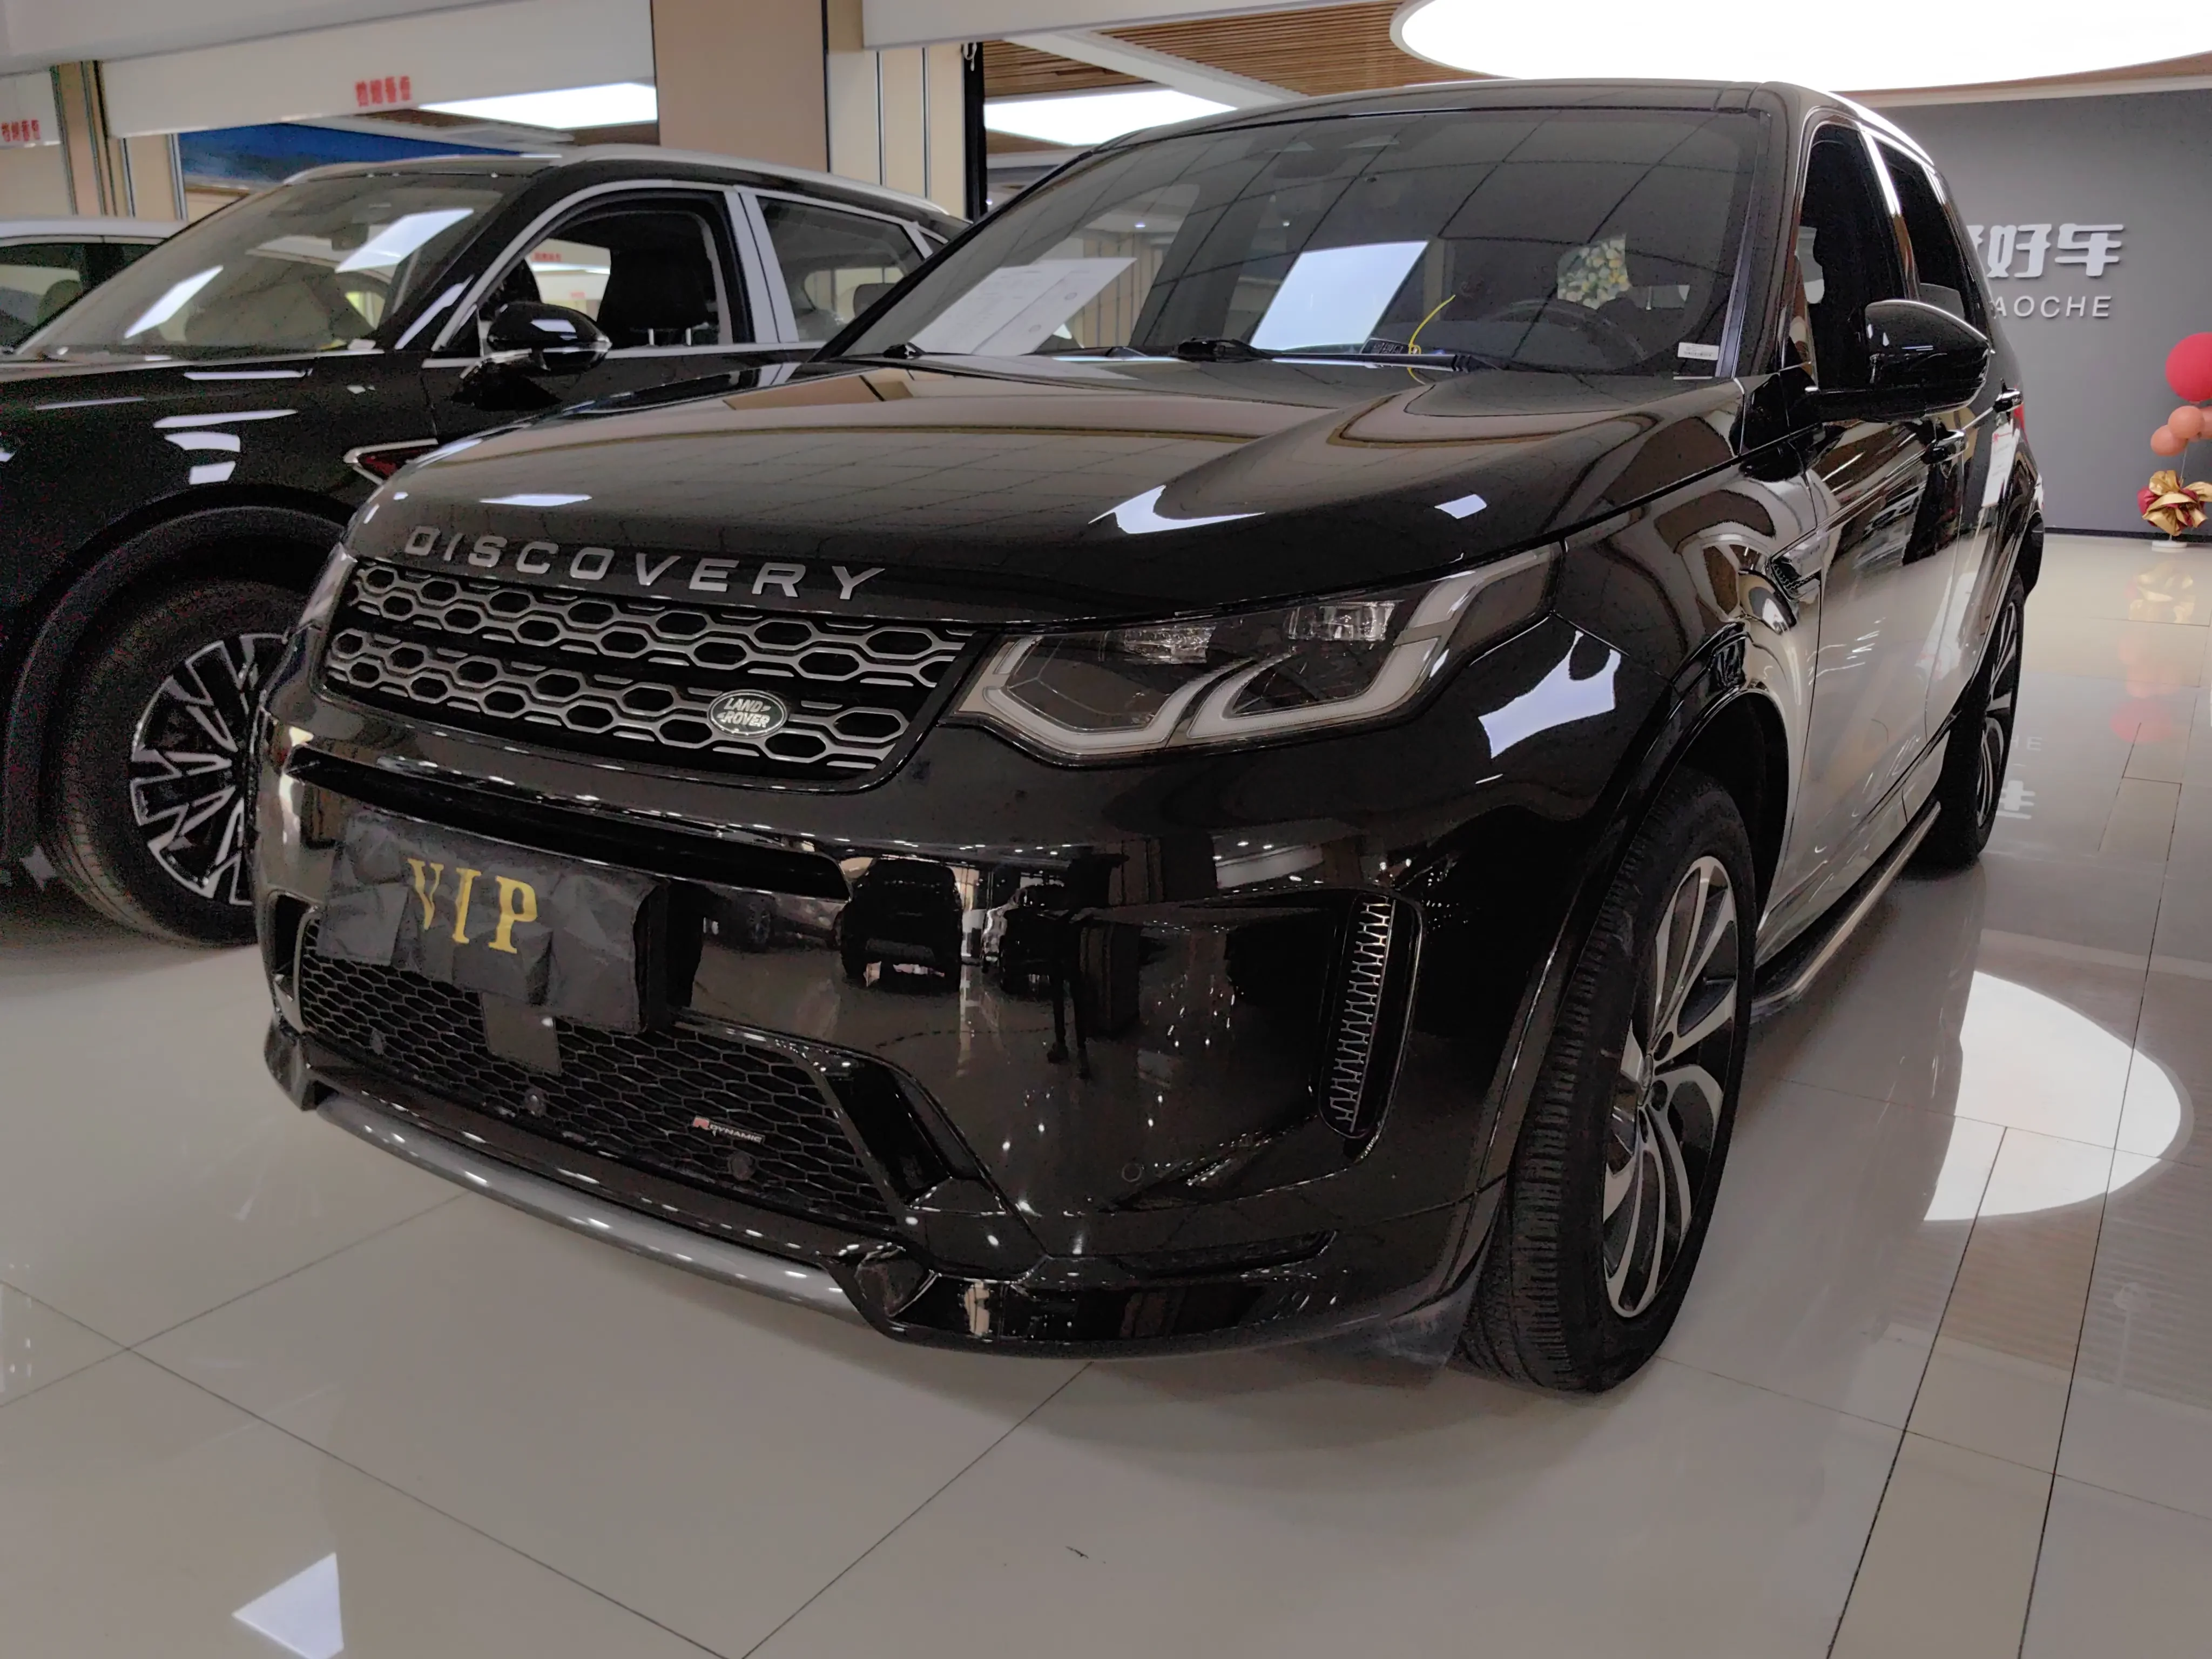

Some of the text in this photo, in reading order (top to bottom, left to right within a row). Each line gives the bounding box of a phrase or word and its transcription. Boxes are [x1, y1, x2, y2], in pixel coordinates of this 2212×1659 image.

[1966, 223, 2123, 278] 好车
[404, 526, 886, 600] DISCOVERY
[723, 710, 771, 728] ROVER
[724, 697, 763, 712] LAND
[407, 858, 538, 954] VIP
